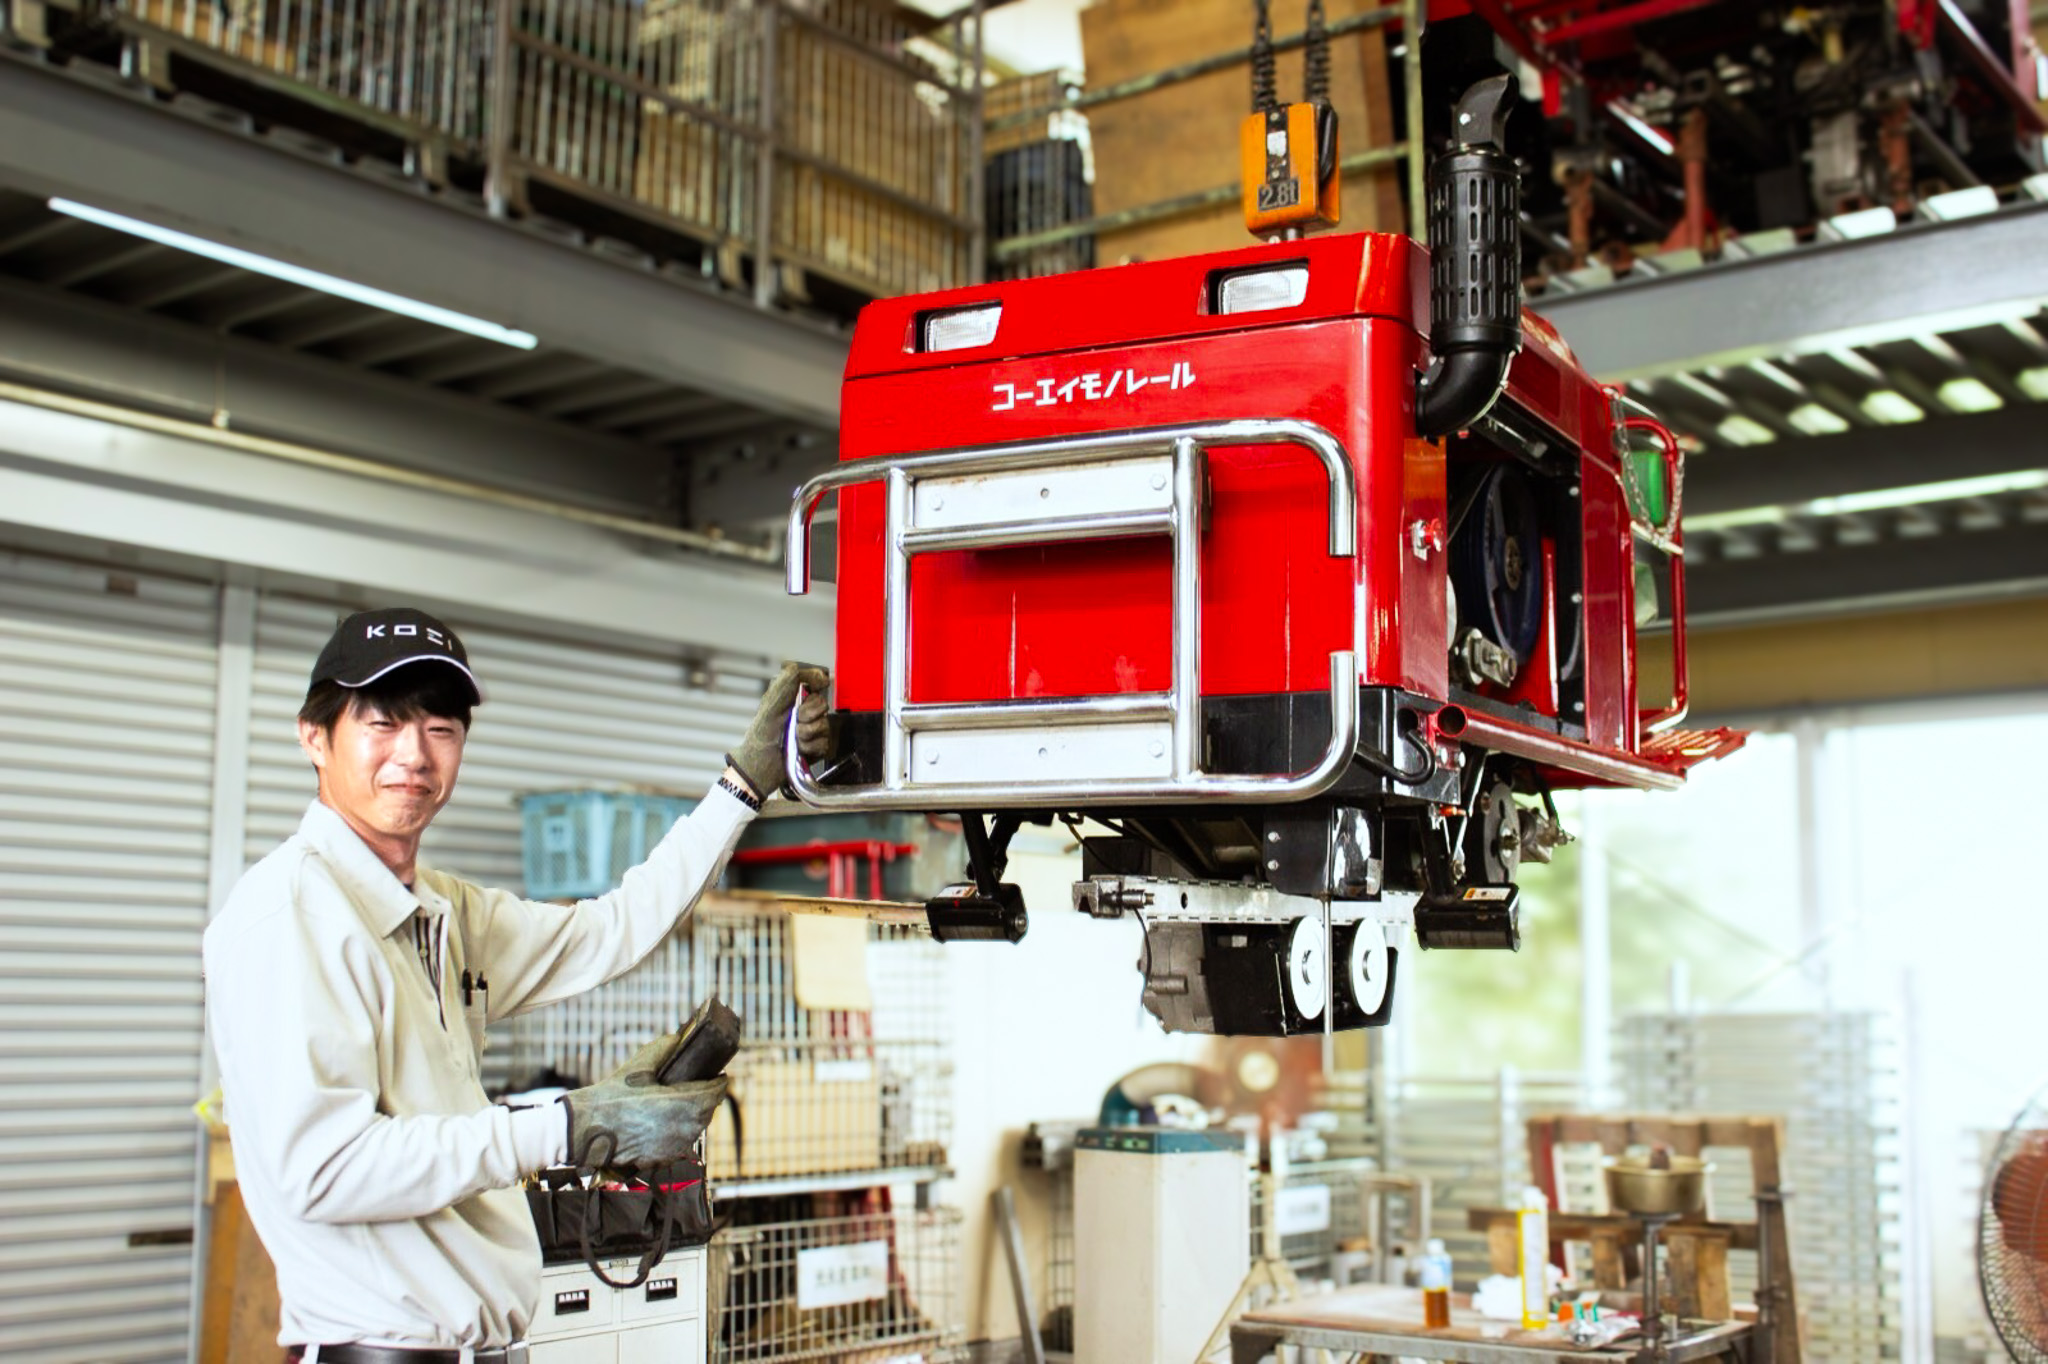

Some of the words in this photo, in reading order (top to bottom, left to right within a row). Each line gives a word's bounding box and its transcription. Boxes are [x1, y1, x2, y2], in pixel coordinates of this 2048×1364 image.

[992, 361, 1196, 411] コーエイモノレール
